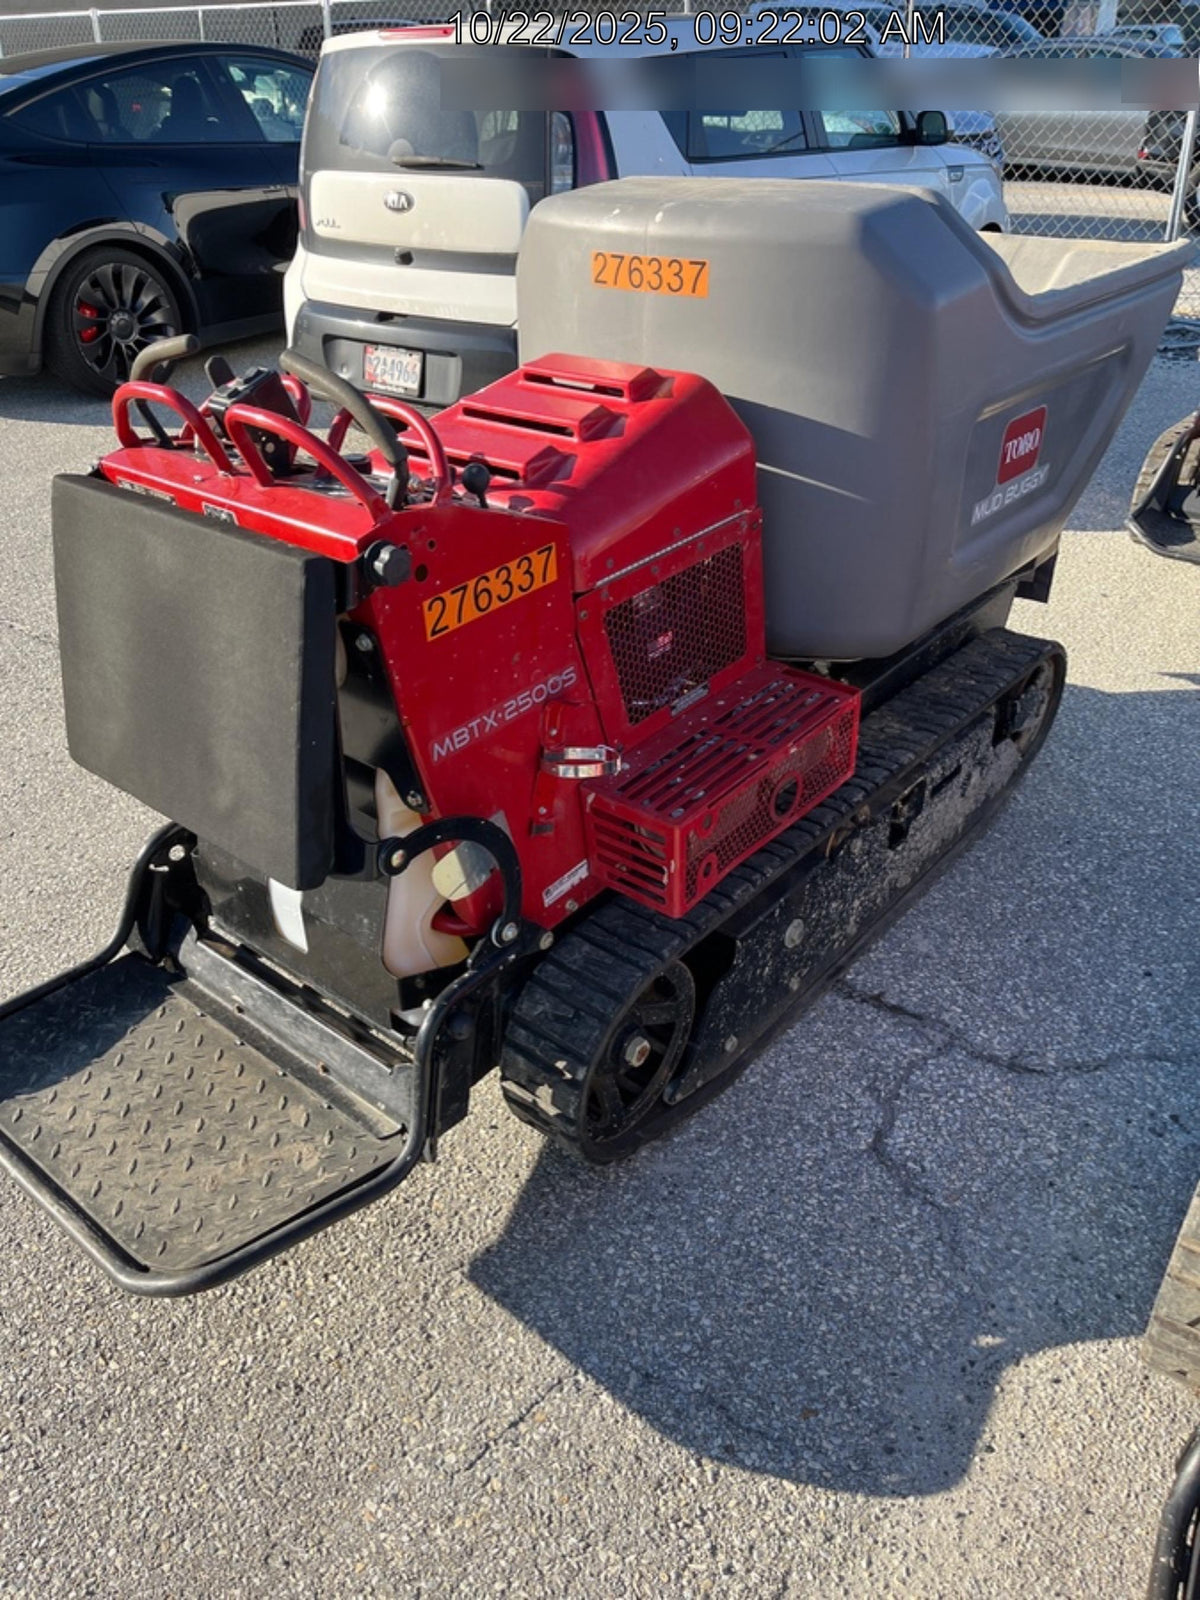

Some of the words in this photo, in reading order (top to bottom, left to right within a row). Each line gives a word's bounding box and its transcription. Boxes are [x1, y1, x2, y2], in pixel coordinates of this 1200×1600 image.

[385, 190, 410, 210] KIA
[593, 251, 707, 294] 276337
[1004, 427, 1041, 465] TORO
[970, 492, 1004, 527] MUD
[1004, 461, 1051, 505] BUGGY
[426, 544, 555, 638] 276337
